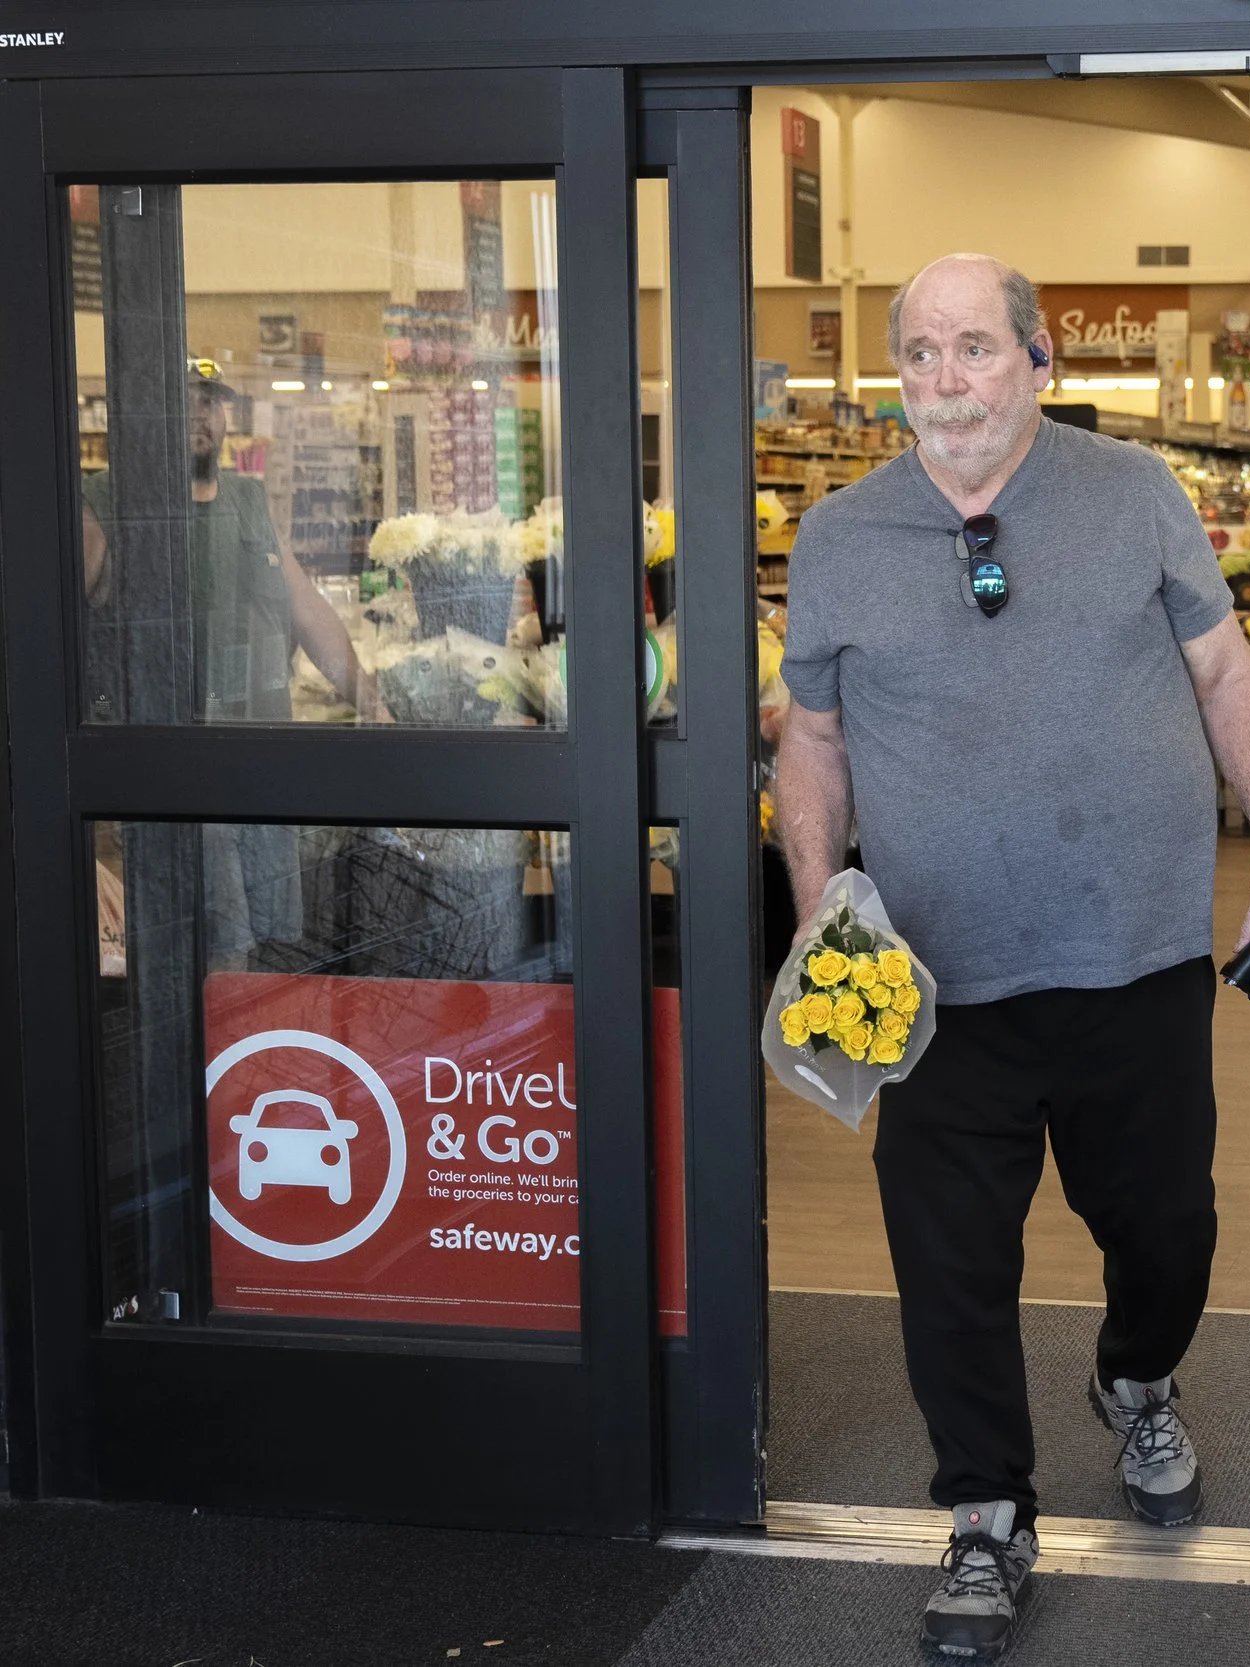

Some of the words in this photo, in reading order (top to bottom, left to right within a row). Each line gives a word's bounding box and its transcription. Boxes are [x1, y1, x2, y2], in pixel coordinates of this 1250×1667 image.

[0, 32, 64, 47] STANLEY
[425, 1056, 577, 1110] DriveU
[426, 1113, 465, 1160] &
[428, 1169, 466, 1182] Order
[469, 1172, 514, 1185] online.
[517, 1173, 549, 1187] We'll
[552, 1175, 578, 1188] brin
[428, 1186, 450, 1197] the
[453, 1188, 514, 1201] groceries
[517, 1190, 531, 1202] to
[534, 1192, 565, 1205] your
[429, 1222, 580, 1261] safeway.c
